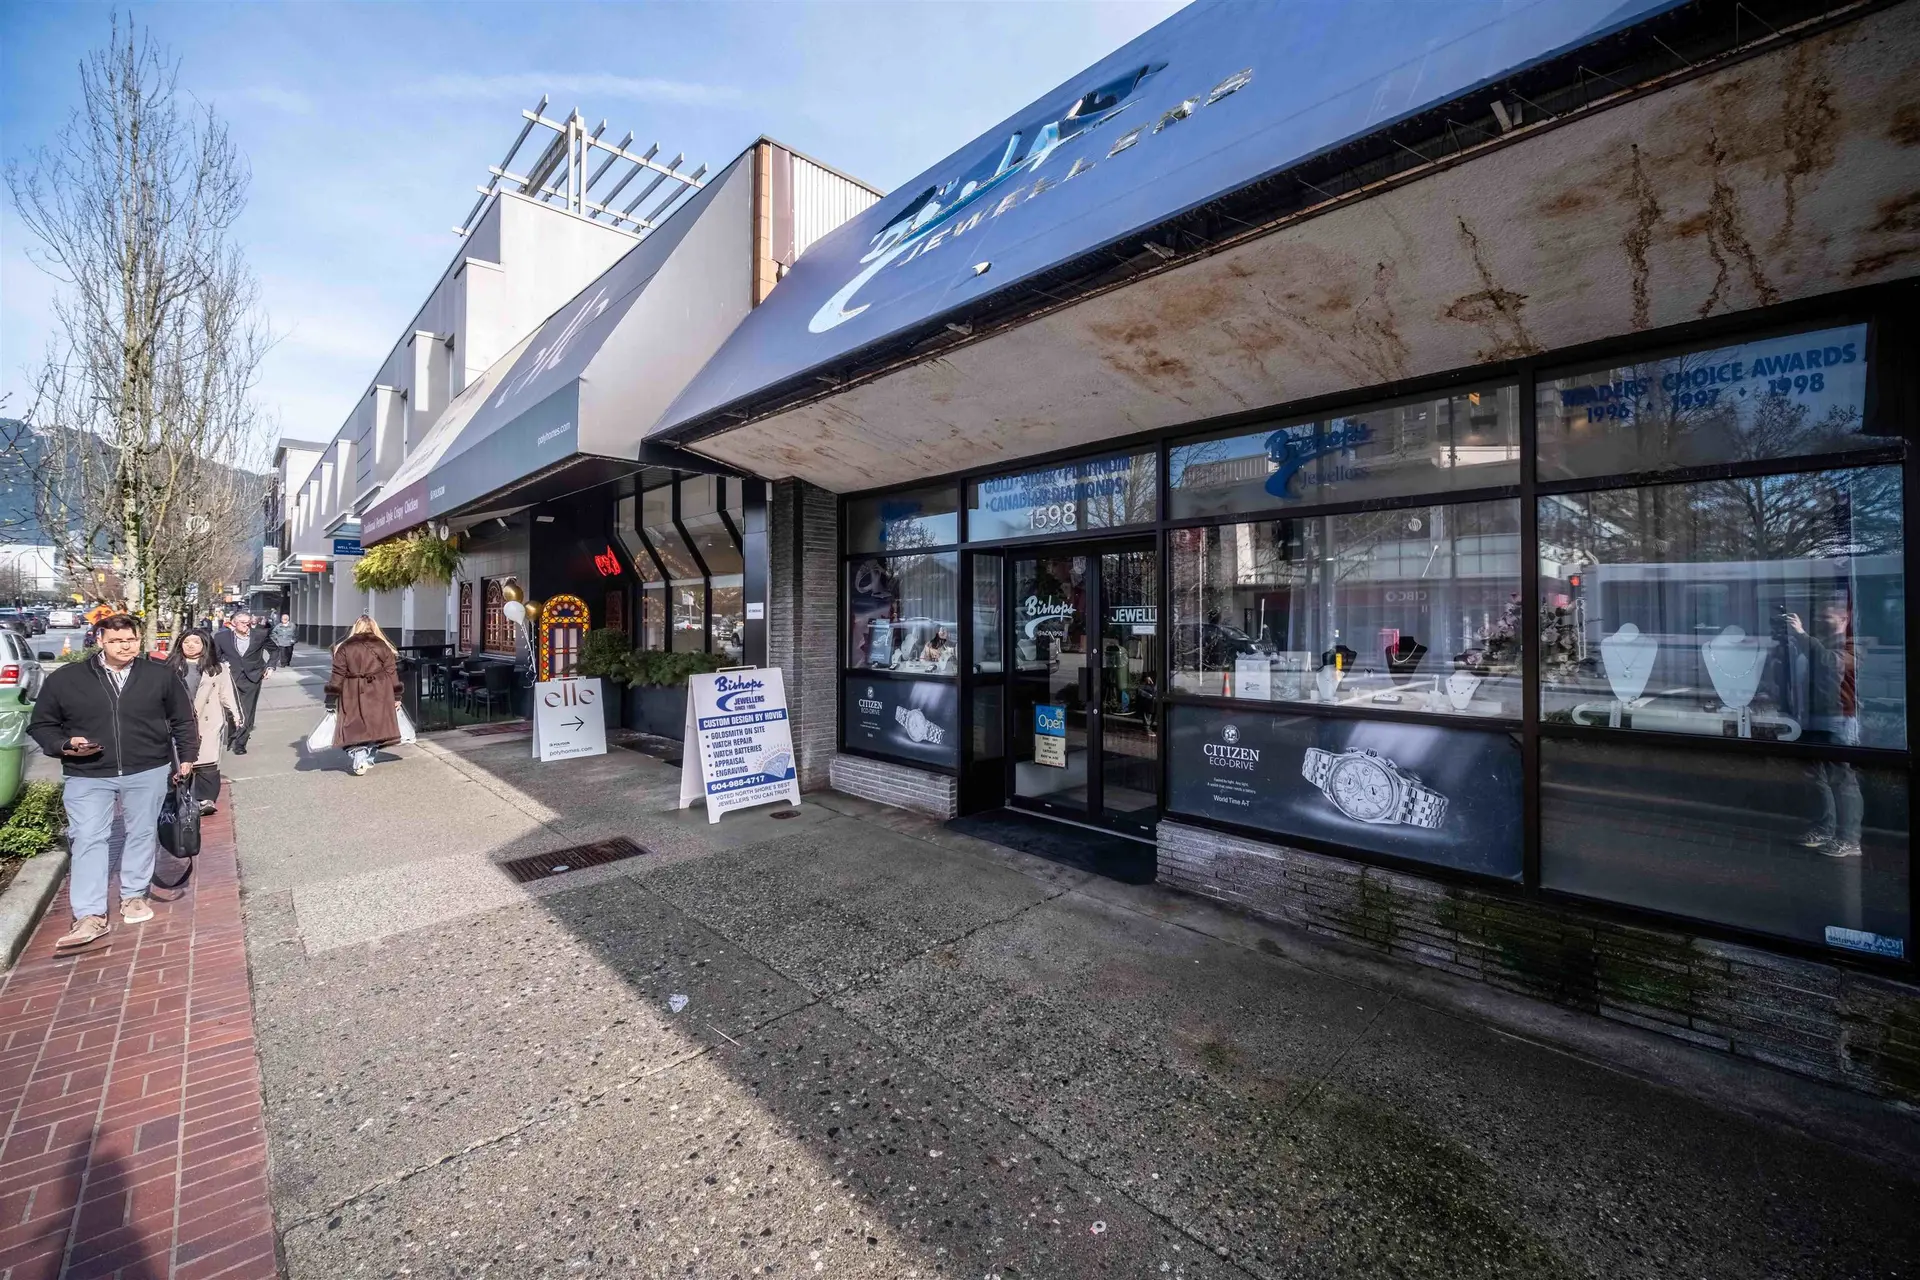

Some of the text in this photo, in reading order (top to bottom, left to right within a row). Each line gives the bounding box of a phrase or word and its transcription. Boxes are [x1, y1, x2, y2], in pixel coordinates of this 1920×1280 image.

[1661, 361, 1743, 392] CHOICE
[1751, 343, 1857, 379] AWARDS
[1767, 372, 1825, 399] 1998
[984, 475, 1013, 494] GOLD
[1025, 502, 1076, 530] 1598
[1025, 594, 1077, 622] Bishops
[1112, 609, 1157, 622] JEWELL
[715, 675, 764, 695] Bishops
[544, 683, 595, 708] elle
[733, 695, 765, 705] JEWELLERS
[859, 699, 883, 709] CITIZEN
[703, 711, 783, 729] CUSTOM DESIGN BY HOVIG
[1038, 714, 1065, 731] Open
[710, 728, 743, 740] GOLDSMITH
[754, 725, 765, 733] SITE
[712, 737, 753, 749] WATCH REPAIR
[550, 746, 593, 756] polyhomes.com
[713, 745, 762, 758] WATCH BATTERIES
[1203, 743, 1260, 762] CITIZEN
[714, 757, 745, 768] APPRAISAL
[1209, 757, 1254, 771] ECO-DRIVE
[715, 766, 748, 777] ENGRAVING
[711, 775, 765, 791] 604-988-4717
[716, 792, 734, 800] VOTED
[735, 789, 754, 798] NORTH
[718, 797, 750, 807] JEWELLERS
[774, 788, 790, 796] TRUST
[1213, 794, 1228, 803] World
[1229, 797, 1241, 806] Time
